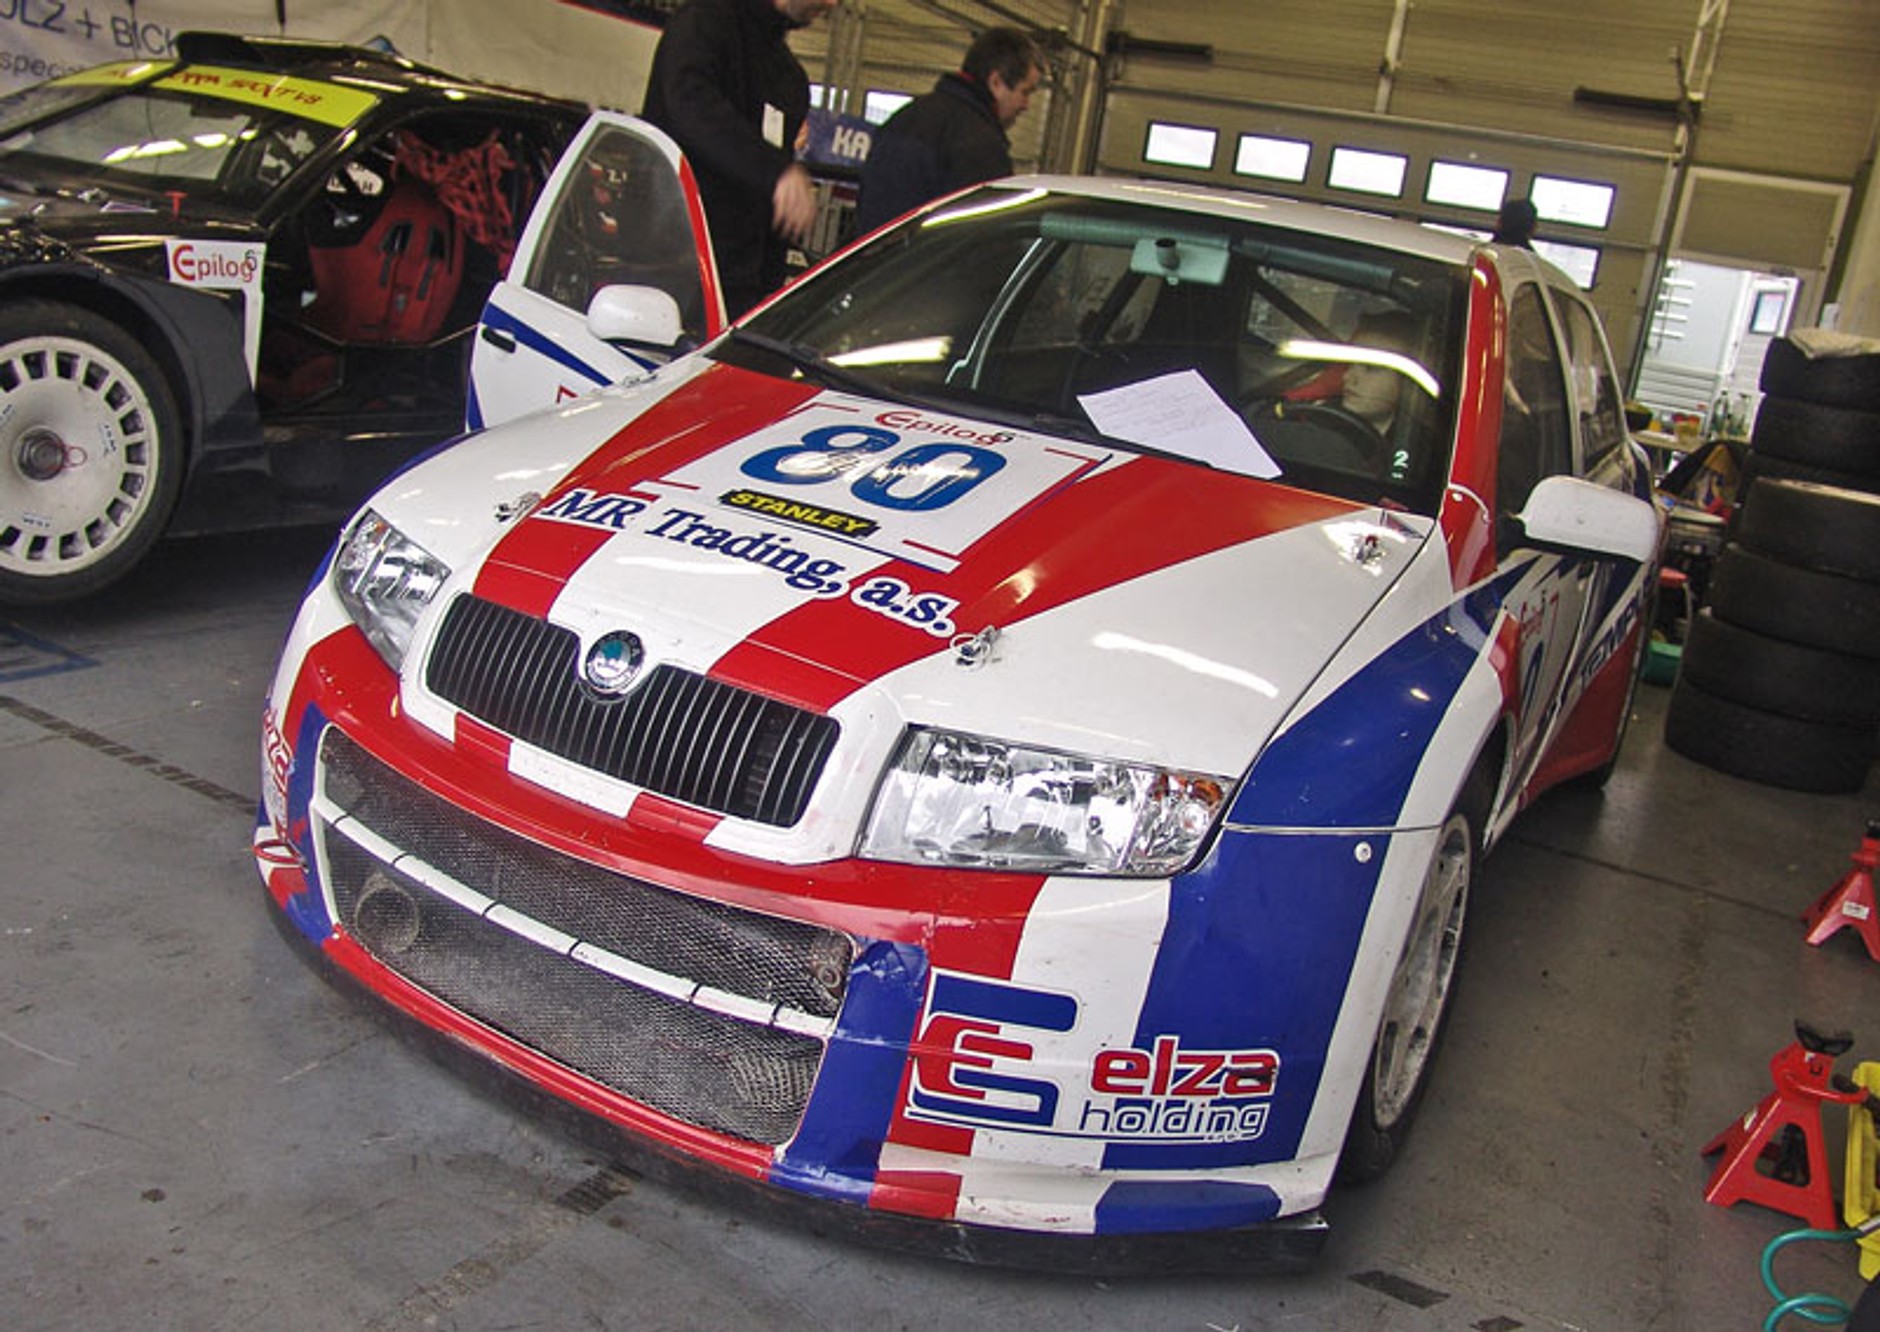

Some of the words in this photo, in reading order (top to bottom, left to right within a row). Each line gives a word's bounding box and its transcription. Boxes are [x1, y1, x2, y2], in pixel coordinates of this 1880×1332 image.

[75, 8, 102, 39] +
[831, 125, 871, 161] KA
[172, 244, 253, 283] Epilog
[875, 411, 996, 446] Epilog
[740, 425, 1007, 511] 80
[730, 492, 870, 533] STANLEY
[540, 491, 646, 530] MR
[644, 508, 845, 593] Trading,
[860, 581, 948, 630] a.s.
[1091, 1037, 1278, 1096] elza
[1079, 1100, 1267, 1138] holding
